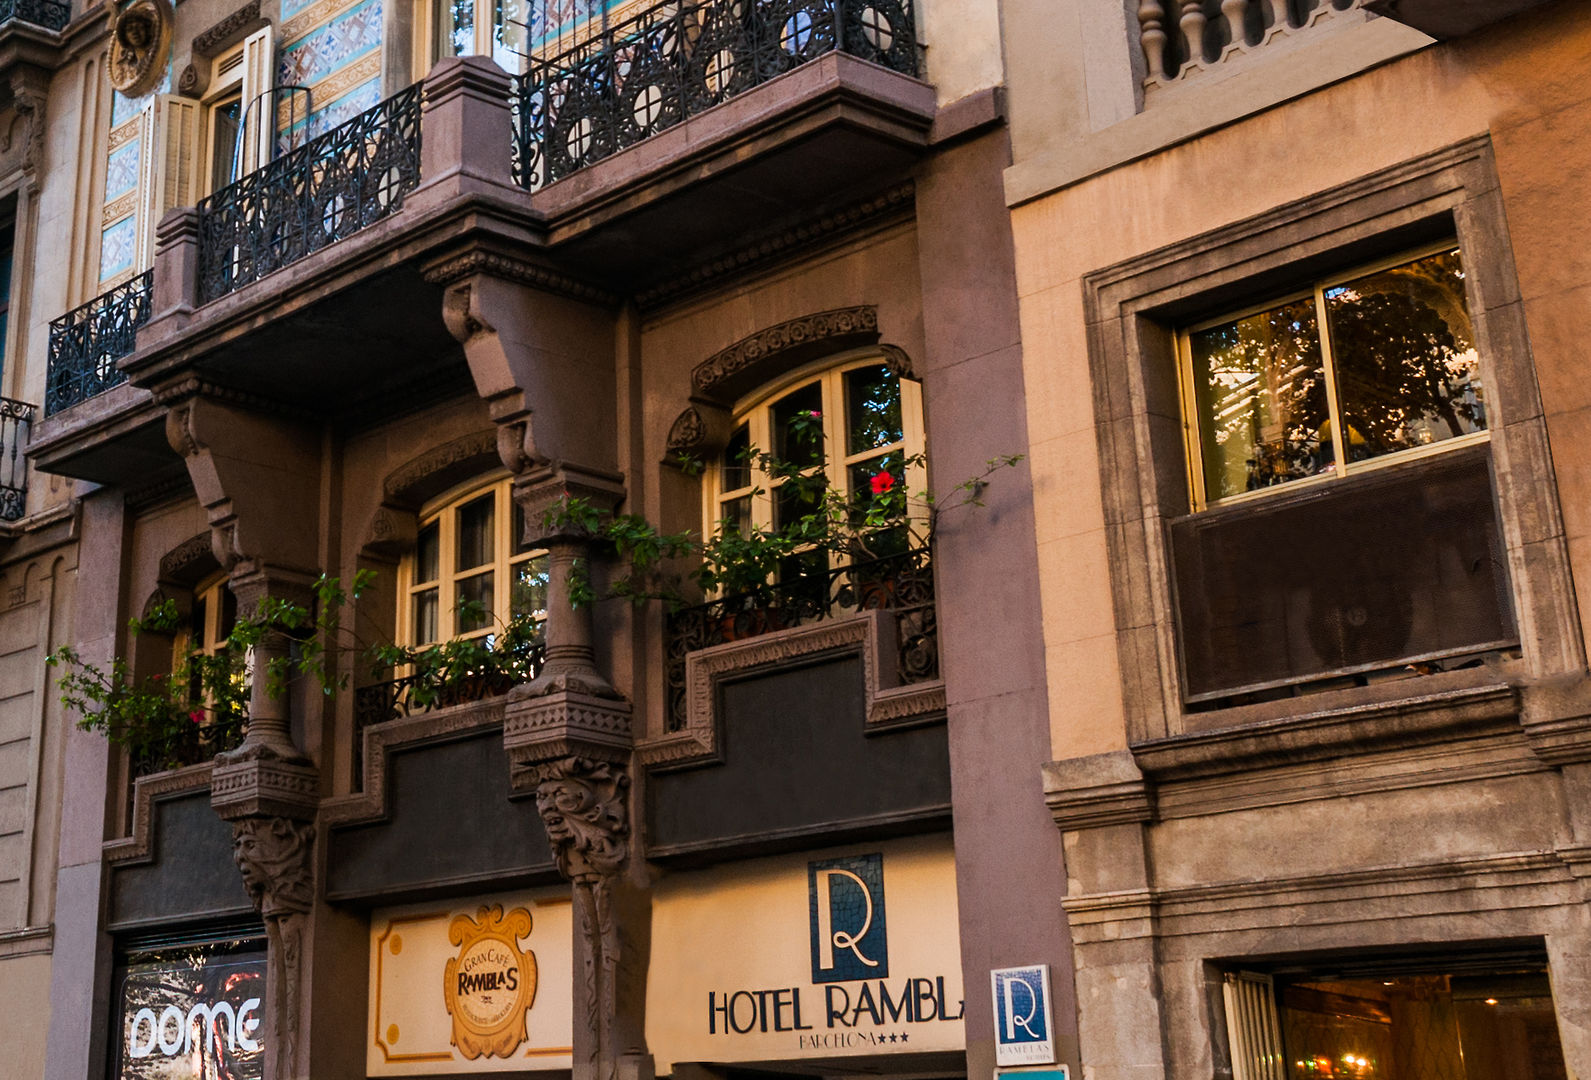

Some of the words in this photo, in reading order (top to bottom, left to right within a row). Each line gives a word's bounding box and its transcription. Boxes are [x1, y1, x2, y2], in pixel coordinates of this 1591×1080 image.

[816, 868, 879, 970] R
[458, 967, 518, 996] RAMBLAS
[464, 952, 487, 972] GRAN
[708, 987, 813, 1035] HOTEL
[824, 976, 965, 1028] RAMBL
[1001, 976, 1040, 1039] R
[799, 1031, 876, 1049] BARCELONA
